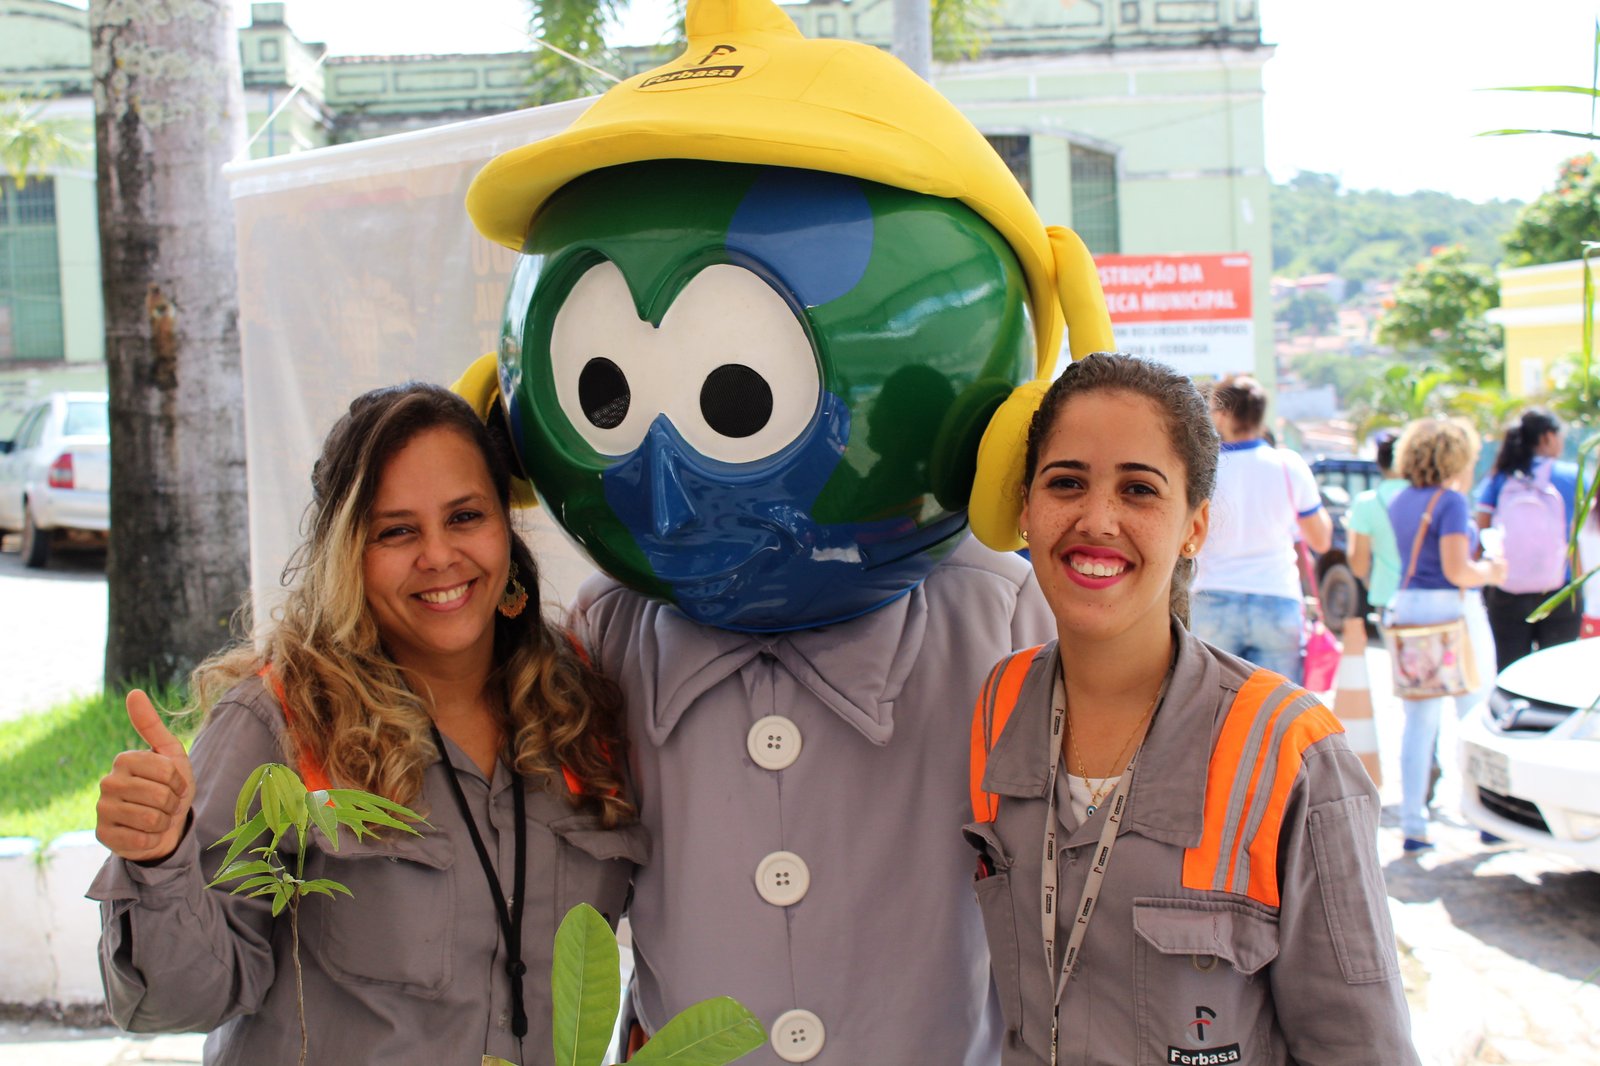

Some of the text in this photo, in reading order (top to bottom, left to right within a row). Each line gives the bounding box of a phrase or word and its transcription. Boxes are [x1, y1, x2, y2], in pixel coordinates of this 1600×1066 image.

[643, 68, 736, 87] Ferbasa
[1097, 261, 1204, 288] STRUÇÃO DA
[1141, 289, 1238, 311] MUNICIPAL
[1170, 1048, 1239, 1066] Ferbasa
